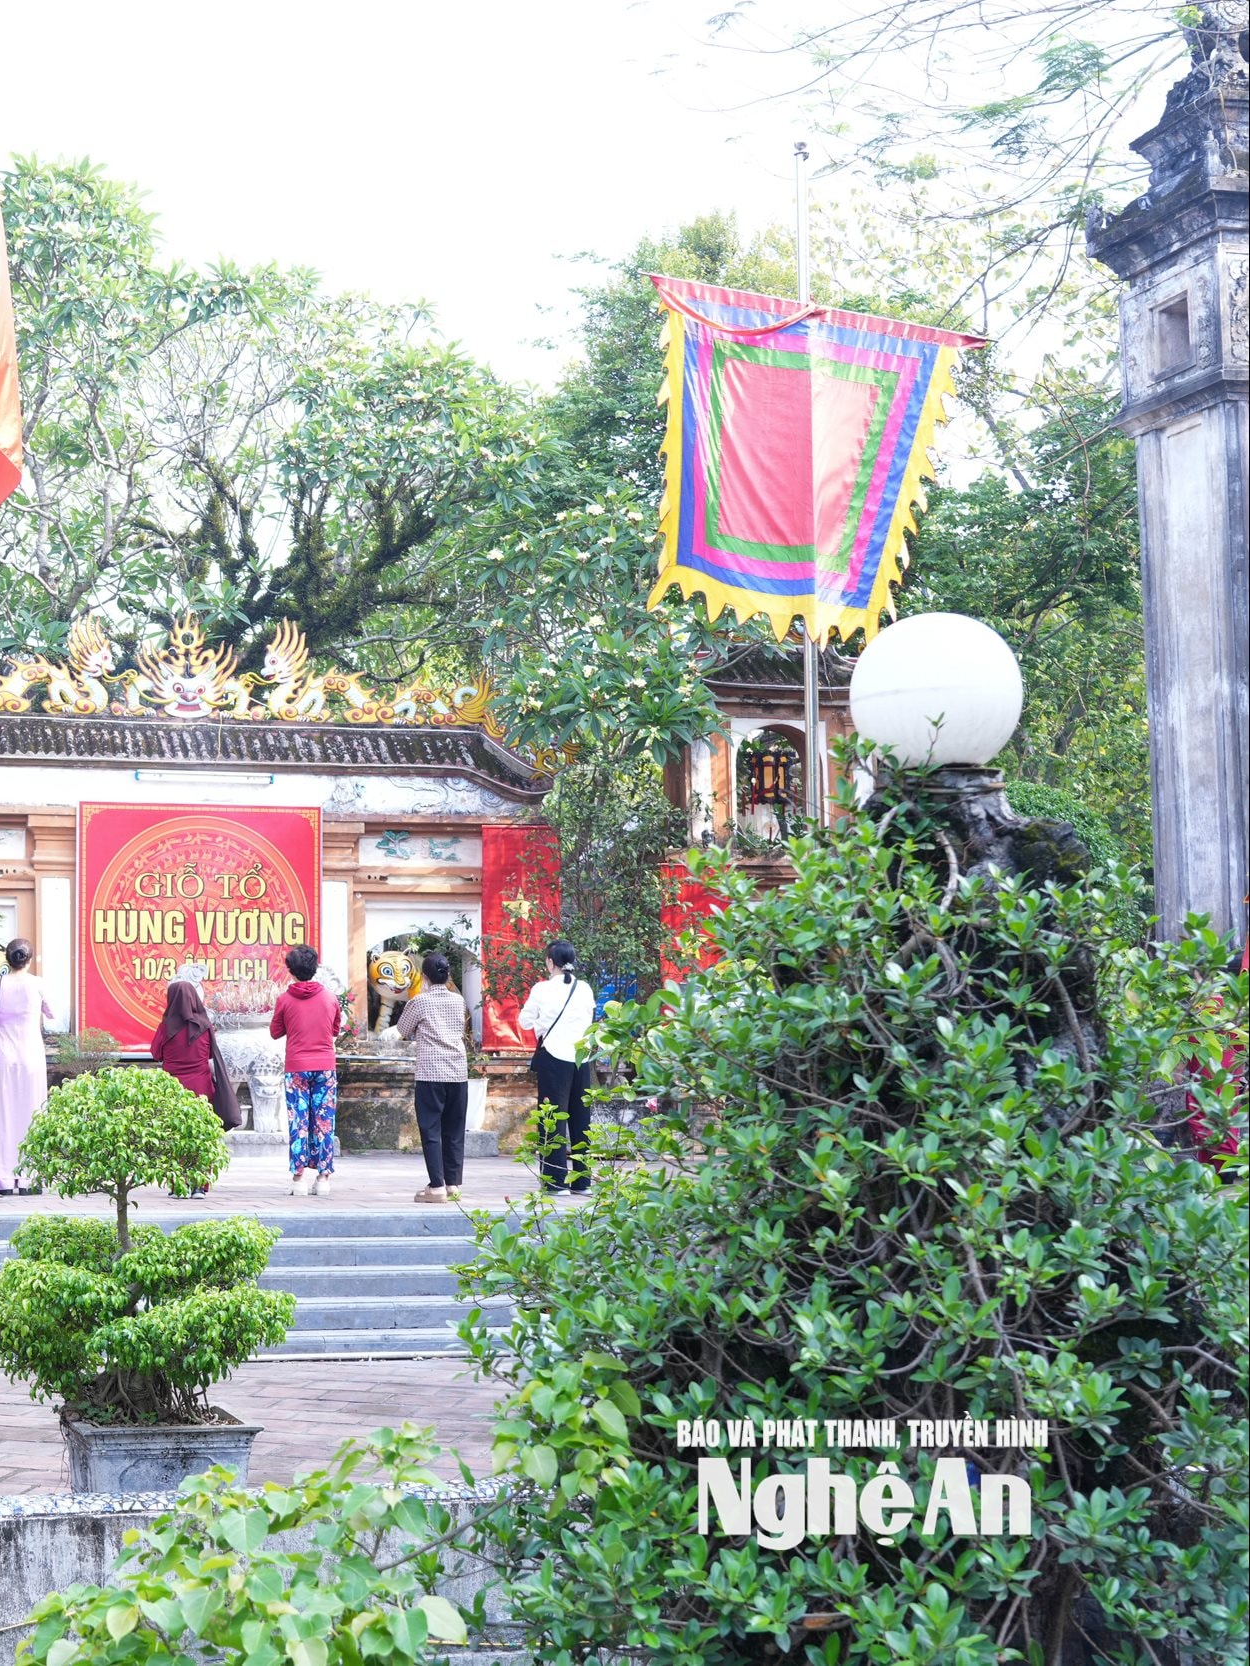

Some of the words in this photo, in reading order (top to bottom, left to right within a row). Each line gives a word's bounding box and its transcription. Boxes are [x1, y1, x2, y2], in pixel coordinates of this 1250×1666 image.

[134, 862, 204, 899] GIỖ
[214, 863, 267, 900] TỔ
[94, 902, 186, 945] HÙNG
[195, 908, 306, 947] VƯƠNG
[132, 957, 177, 981] 10/3
[222, 958, 268, 987] LỊCH
